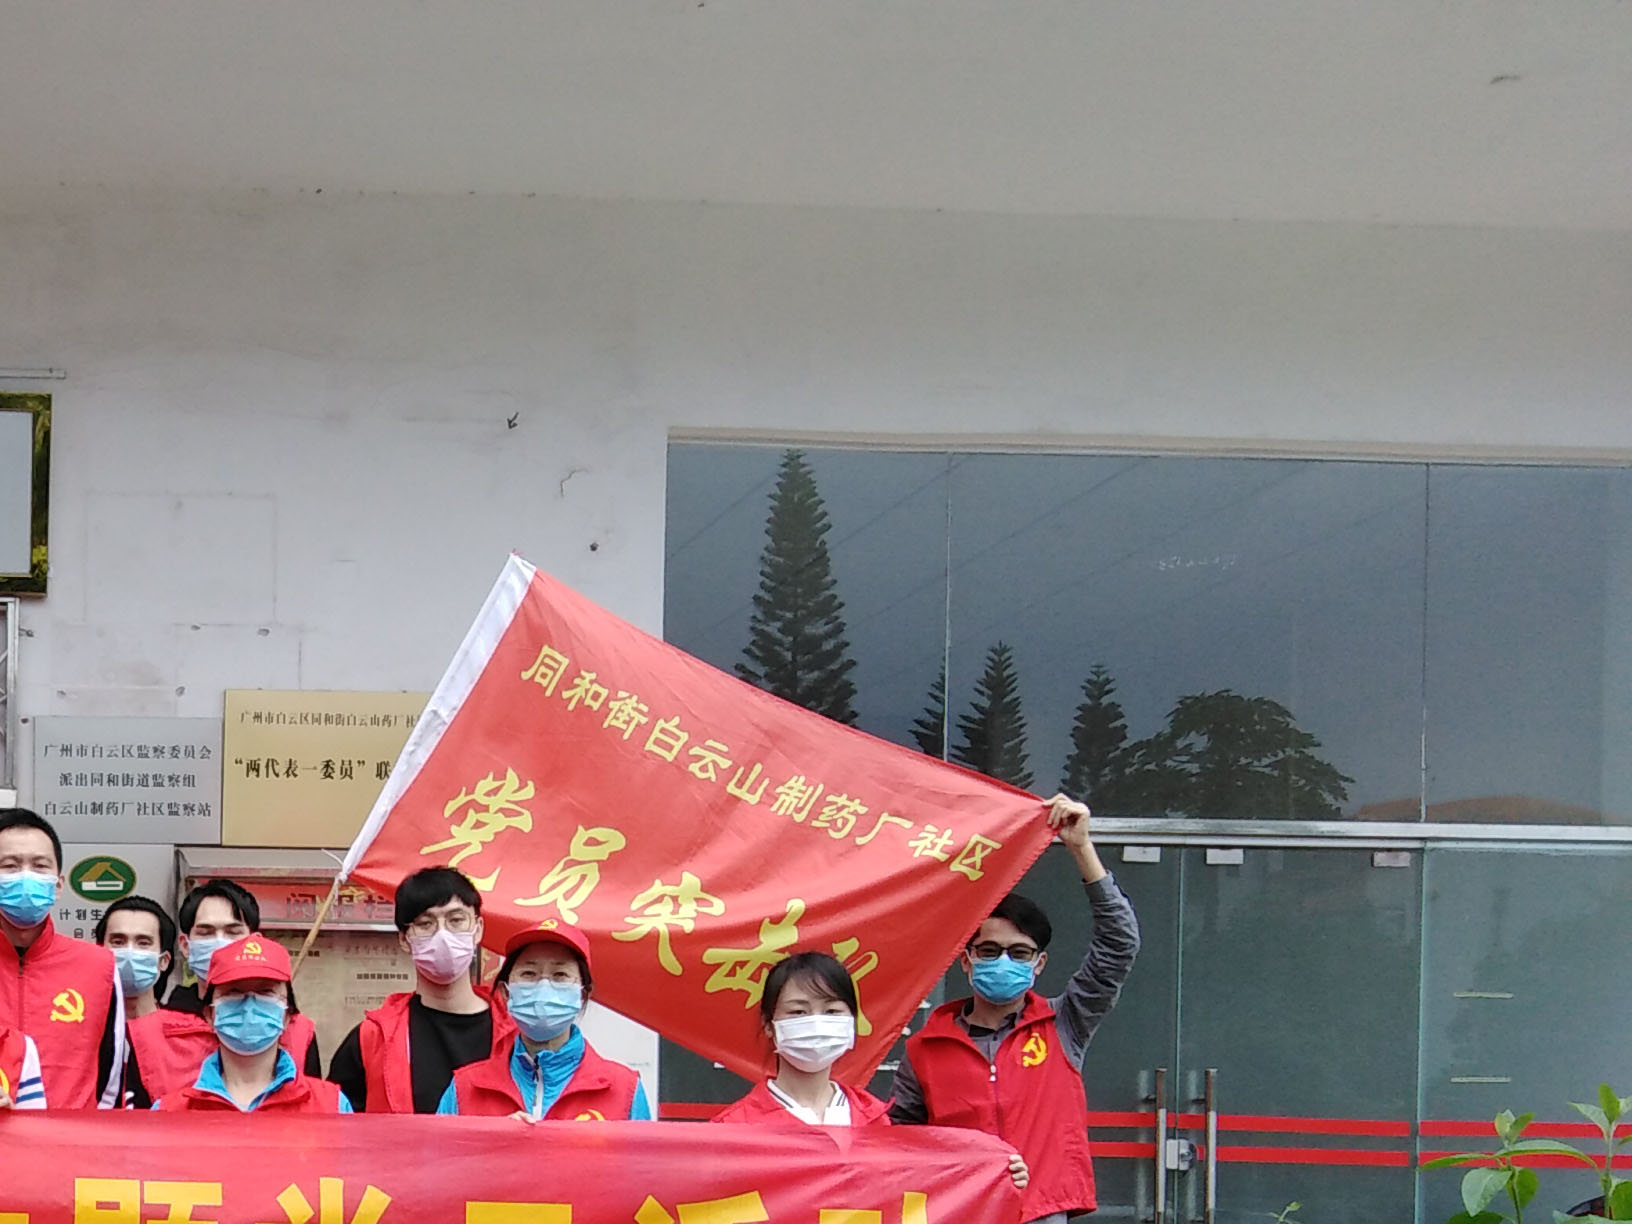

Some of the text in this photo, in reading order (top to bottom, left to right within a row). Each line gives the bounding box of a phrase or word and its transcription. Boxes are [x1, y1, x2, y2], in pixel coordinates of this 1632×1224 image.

[43, 743, 213, 760] 广州市白云区监察委员会
[520, 645, 1004, 881] 同和街白云山制药厂社区
[58, 772, 197, 789] 派出同和街道监察组
[43, 801, 213, 818] 白云山制药厂社区监察站
